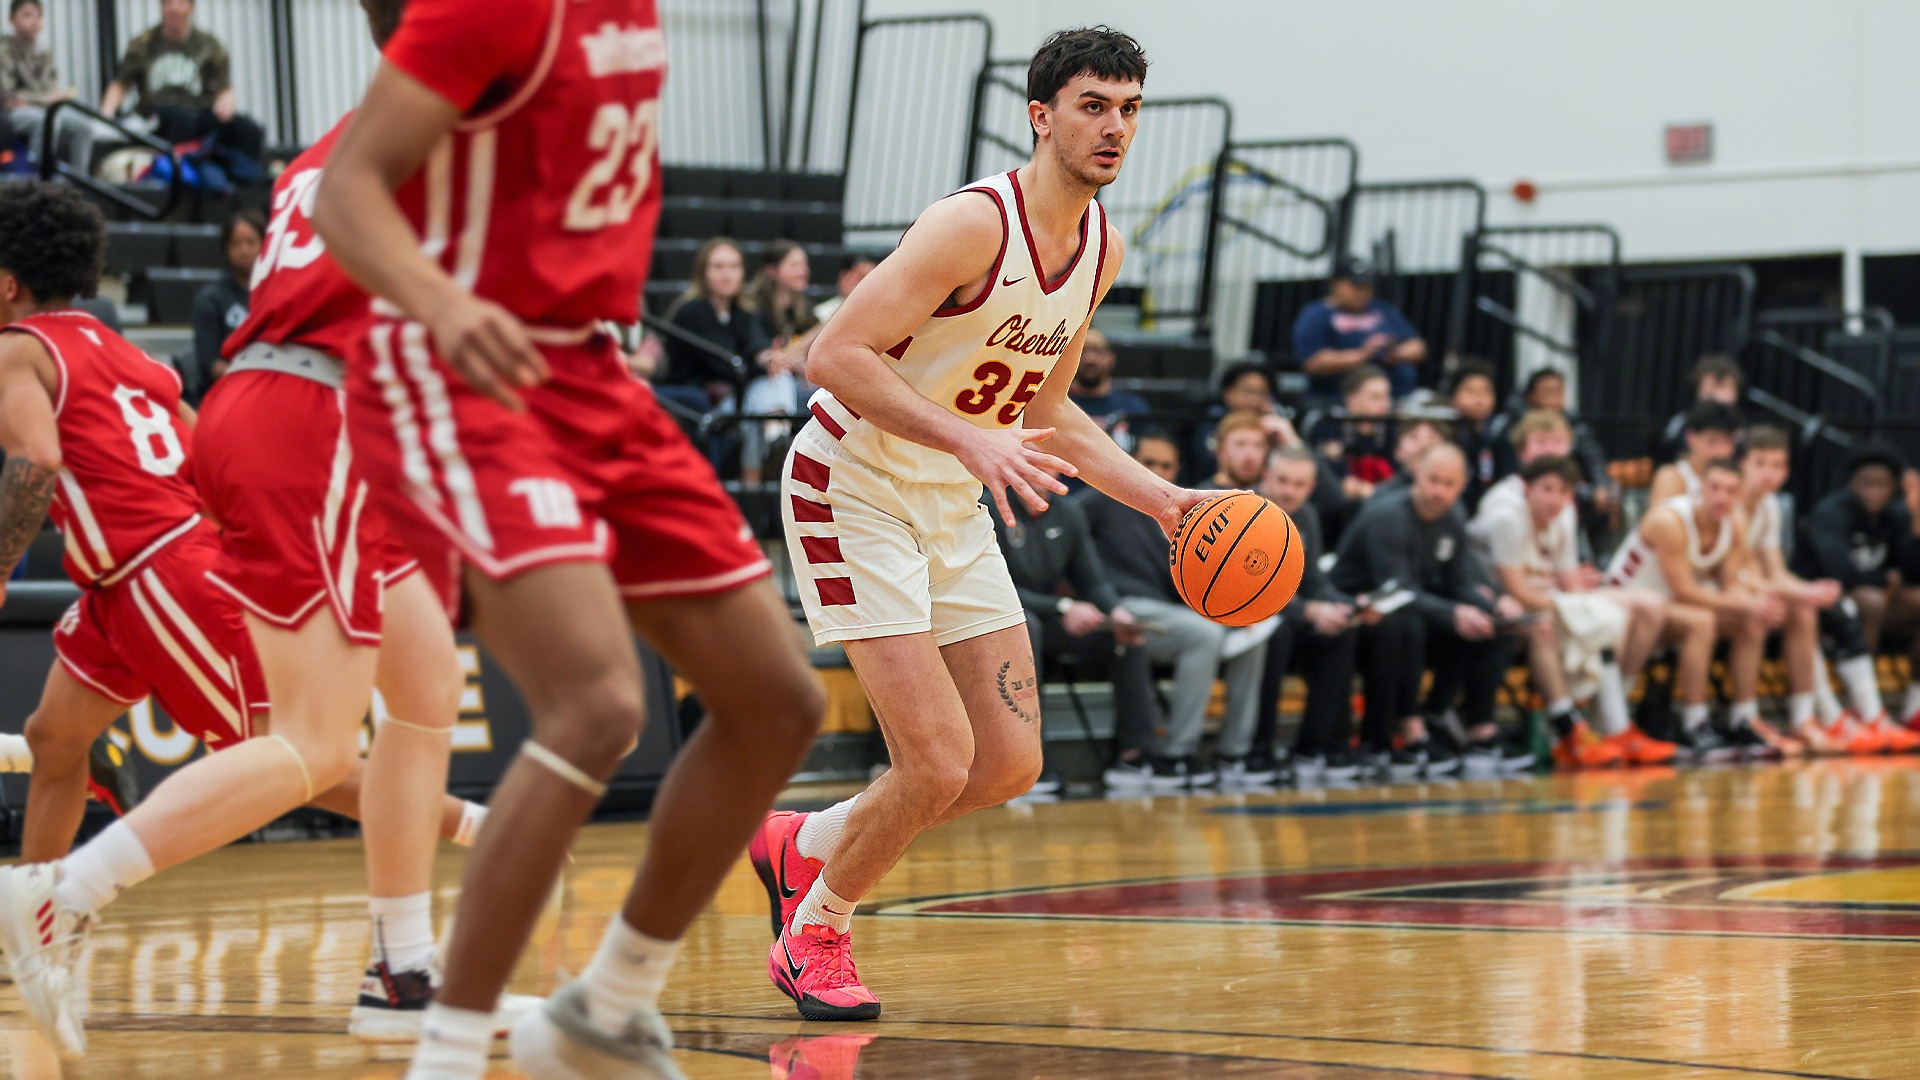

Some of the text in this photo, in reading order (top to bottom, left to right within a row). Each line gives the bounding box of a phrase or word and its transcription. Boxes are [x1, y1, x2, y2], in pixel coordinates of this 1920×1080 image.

[563, 99, 659, 229] 23
[112, 384, 186, 476] 8
[954, 360, 1045, 426] 35
